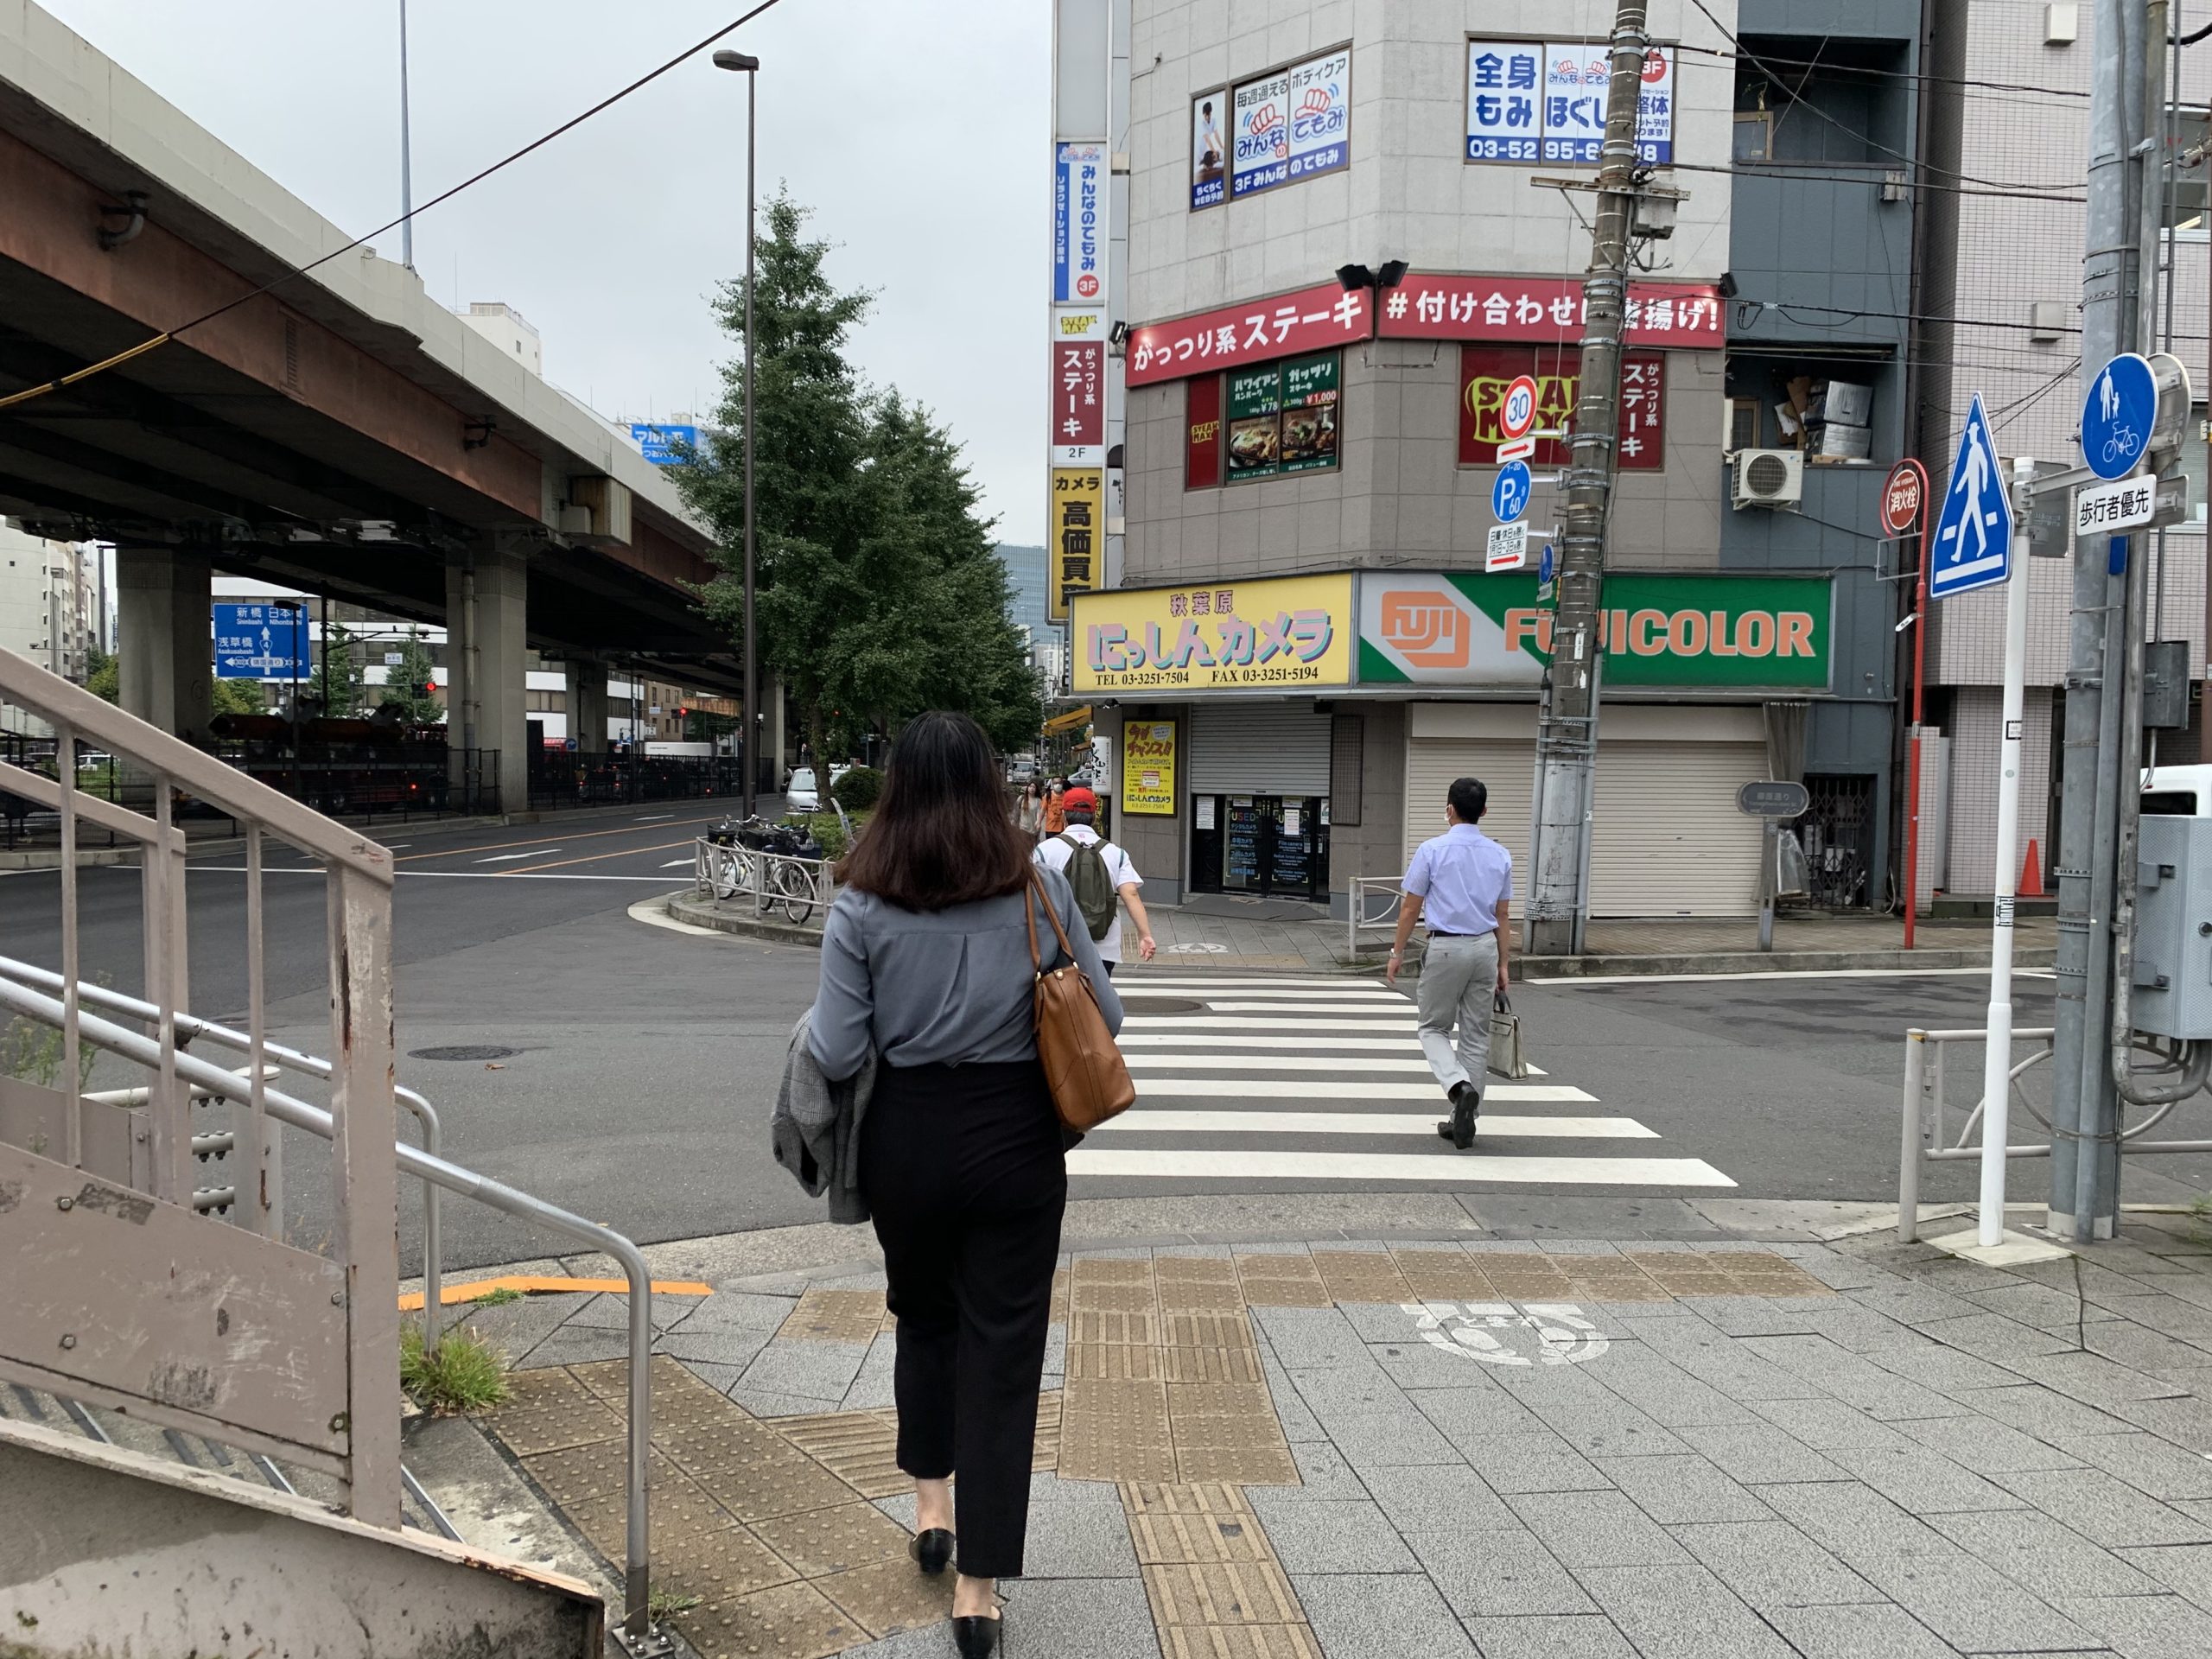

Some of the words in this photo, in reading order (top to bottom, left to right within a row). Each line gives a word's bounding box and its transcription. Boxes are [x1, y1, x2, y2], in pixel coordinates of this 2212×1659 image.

[1474, 53, 1536, 90] 全身
[1081, 165, 1096, 270] みんなのてもみ
[1079, 280, 1097, 292] 3F
[1134, 323, 1236, 372] がっつり系
[1243, 291, 1363, 350] ステーキ
[1084, 348, 1096, 405] がっつり系
[1235, 373, 1279, 392] ハワイアン
[1288, 362, 1332, 383] ガッツリ
[1063, 350, 1083, 437] ステーキ
[1306, 391, 1337, 404] ¥1,000
[1646, 363, 1659, 428] がっつり系
[1509, 393, 1529, 423] 30
[1621, 364, 1644, 457] ステーキ
[1068, 447, 1086, 458] 2F
[1055, 477, 1100, 491] カメラ
[1499, 478, 1516, 518] P
[1891, 486, 1917, 513] 消火栓
[2080, 487, 2150, 527] 歩行者優先
[237, 607, 262, 618] 新橋
[1170, 590, 1233, 617] 秋葉原
[218, 637, 253, 648] 浅草橋
[1087, 608, 1334, 671] にっしんカメラ
[1096, 674, 1117, 685] TEL
[1122, 671, 1189, 684] 03-3251-7504
[1211, 670, 1238, 682] FAX
[1243, 666, 1319, 682] 03-3251-5194
